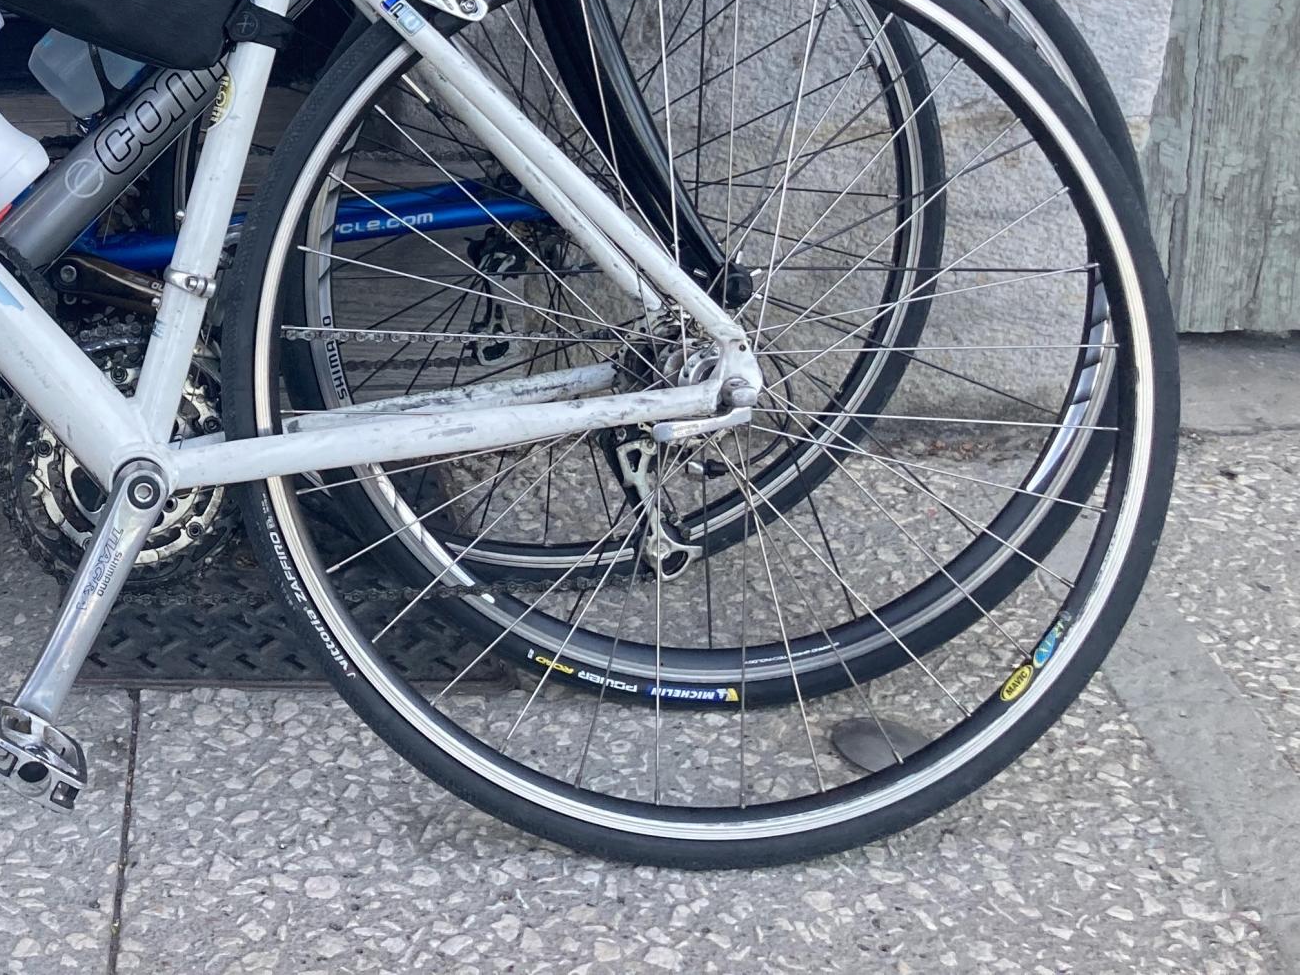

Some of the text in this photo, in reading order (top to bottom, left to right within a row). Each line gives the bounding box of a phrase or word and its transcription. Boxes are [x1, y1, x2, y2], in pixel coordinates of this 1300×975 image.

[322, 315, 348, 400] SHIMAO
[269, 531, 308, 603] ZAFFIRO
[577, 670, 638, 693] POWER
[651, 687, 716, 701] MICHELIN
[1005, 670, 1028, 696] MAVIC
